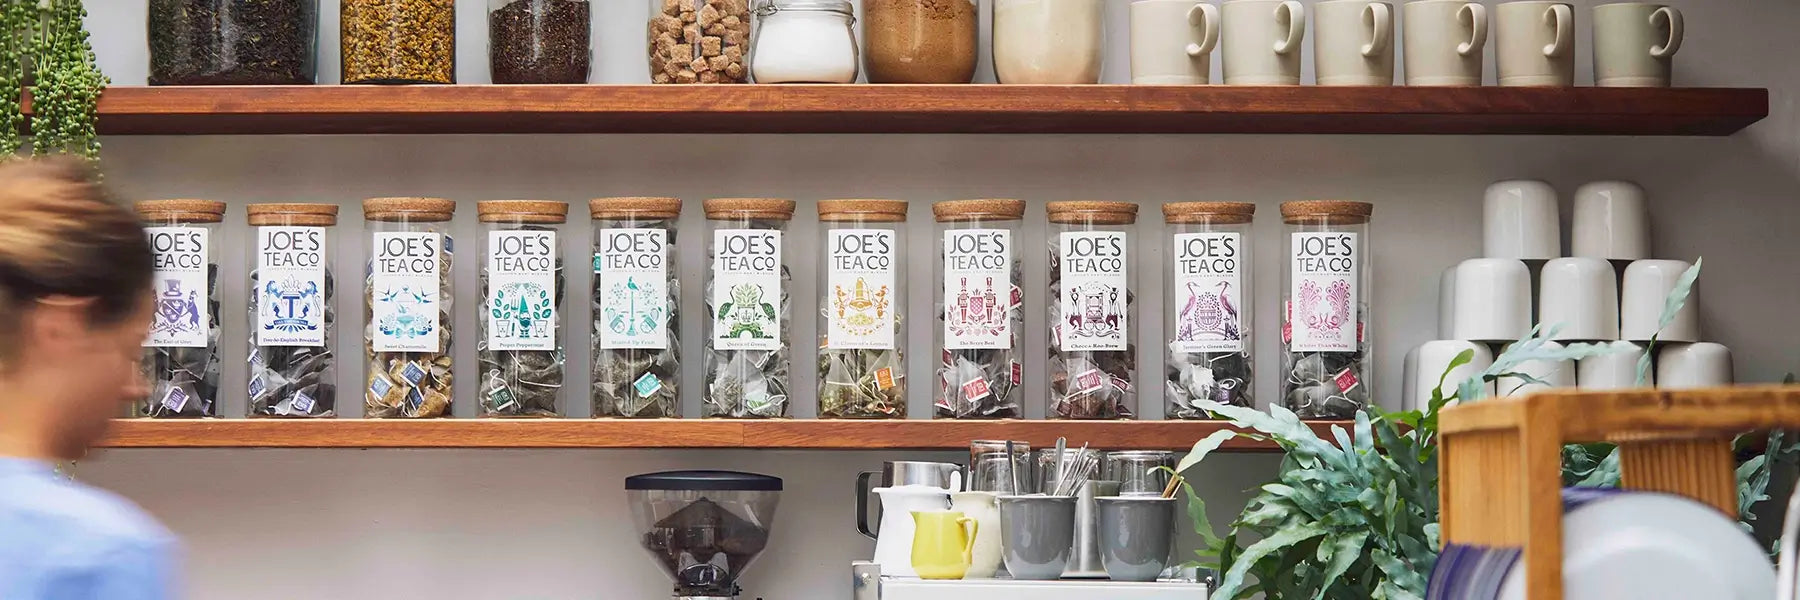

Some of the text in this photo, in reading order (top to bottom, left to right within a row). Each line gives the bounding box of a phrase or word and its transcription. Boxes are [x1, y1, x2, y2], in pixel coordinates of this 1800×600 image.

[264, 229, 319, 251] JOE'S
[380, 236, 434, 257] JOE'S
[495, 234, 549, 255] JOE'S
[606, 231, 661, 252] JOE'S
[720, 233, 775, 255] JOE'S
[834, 232, 889, 254] JOE'S
[950, 232, 1004, 254] JOE'S
[1067, 235, 1121, 257] JOE'S
[1180, 235, 1234, 258] JOE'S
[1297, 234, 1352, 256] JOE'S
[152, 254, 176, 268] EA
[264, 253, 294, 266] TEA
[380, 259, 408, 272] TEA
[495, 257, 524, 271] TEA
[606, 255, 635, 268] TEA
[720, 257, 749, 270] TEA
[835, 256, 864, 269] TEA
[950, 256, 979, 269] TEA
[1067, 259, 1097, 272] TEA
[1180, 260, 1210, 273] TEA
[1297, 258, 1326, 271] TEA
